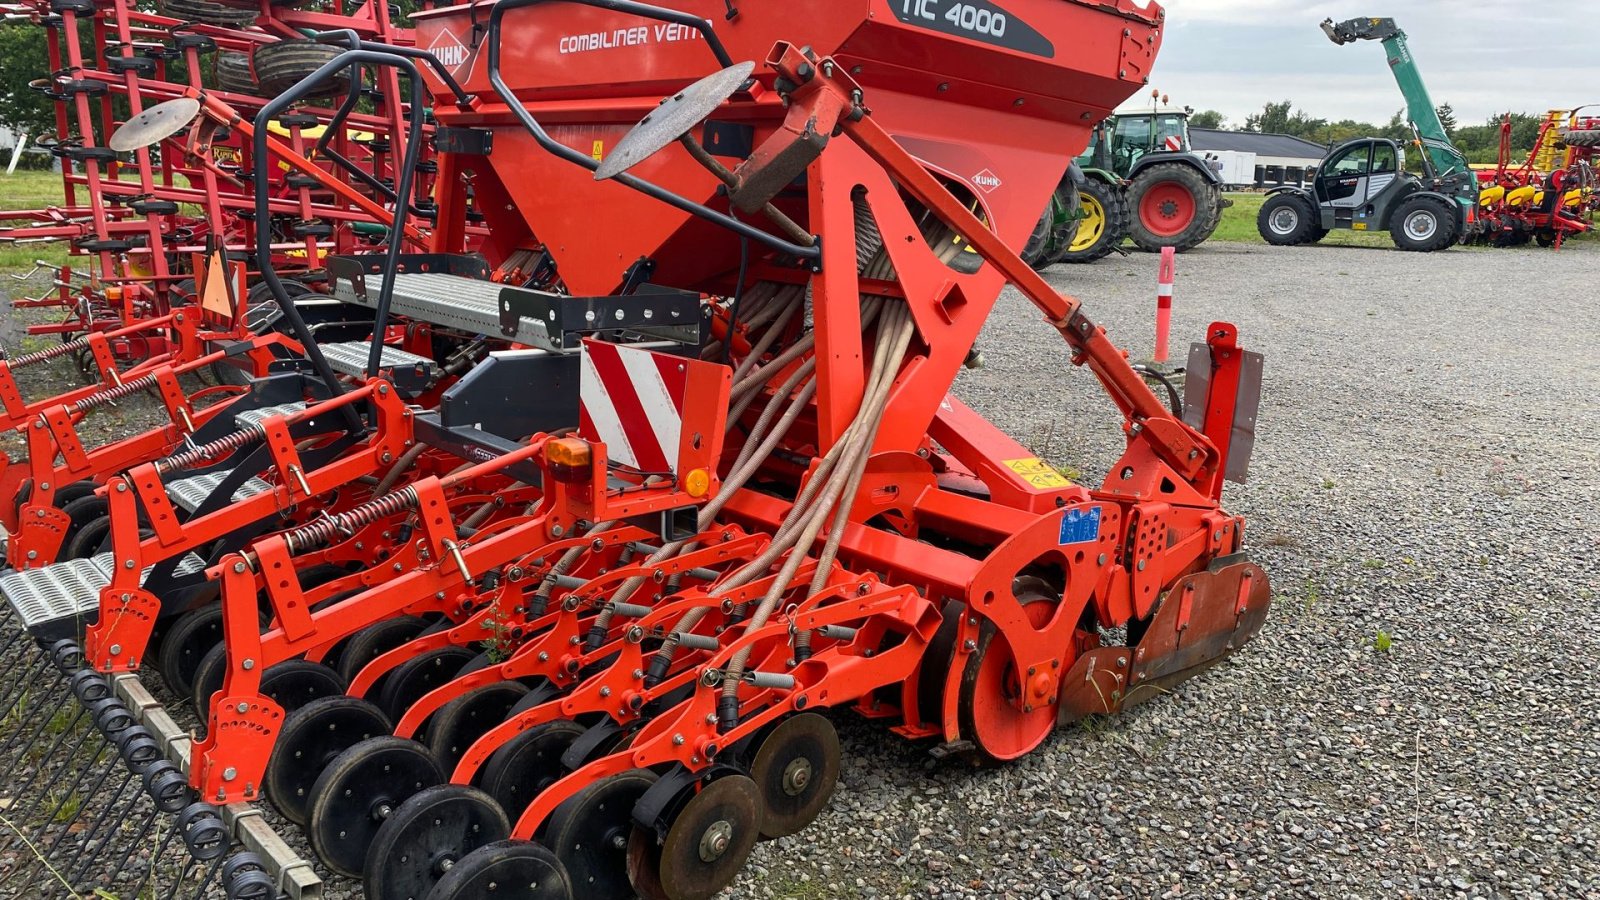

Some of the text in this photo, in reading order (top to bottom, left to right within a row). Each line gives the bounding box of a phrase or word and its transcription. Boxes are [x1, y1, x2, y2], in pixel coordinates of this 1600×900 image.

[944, 2, 1006, 38] 4000
[559, 27, 648, 54] COMBILINER
[975, 175, 998, 186] KUHN
